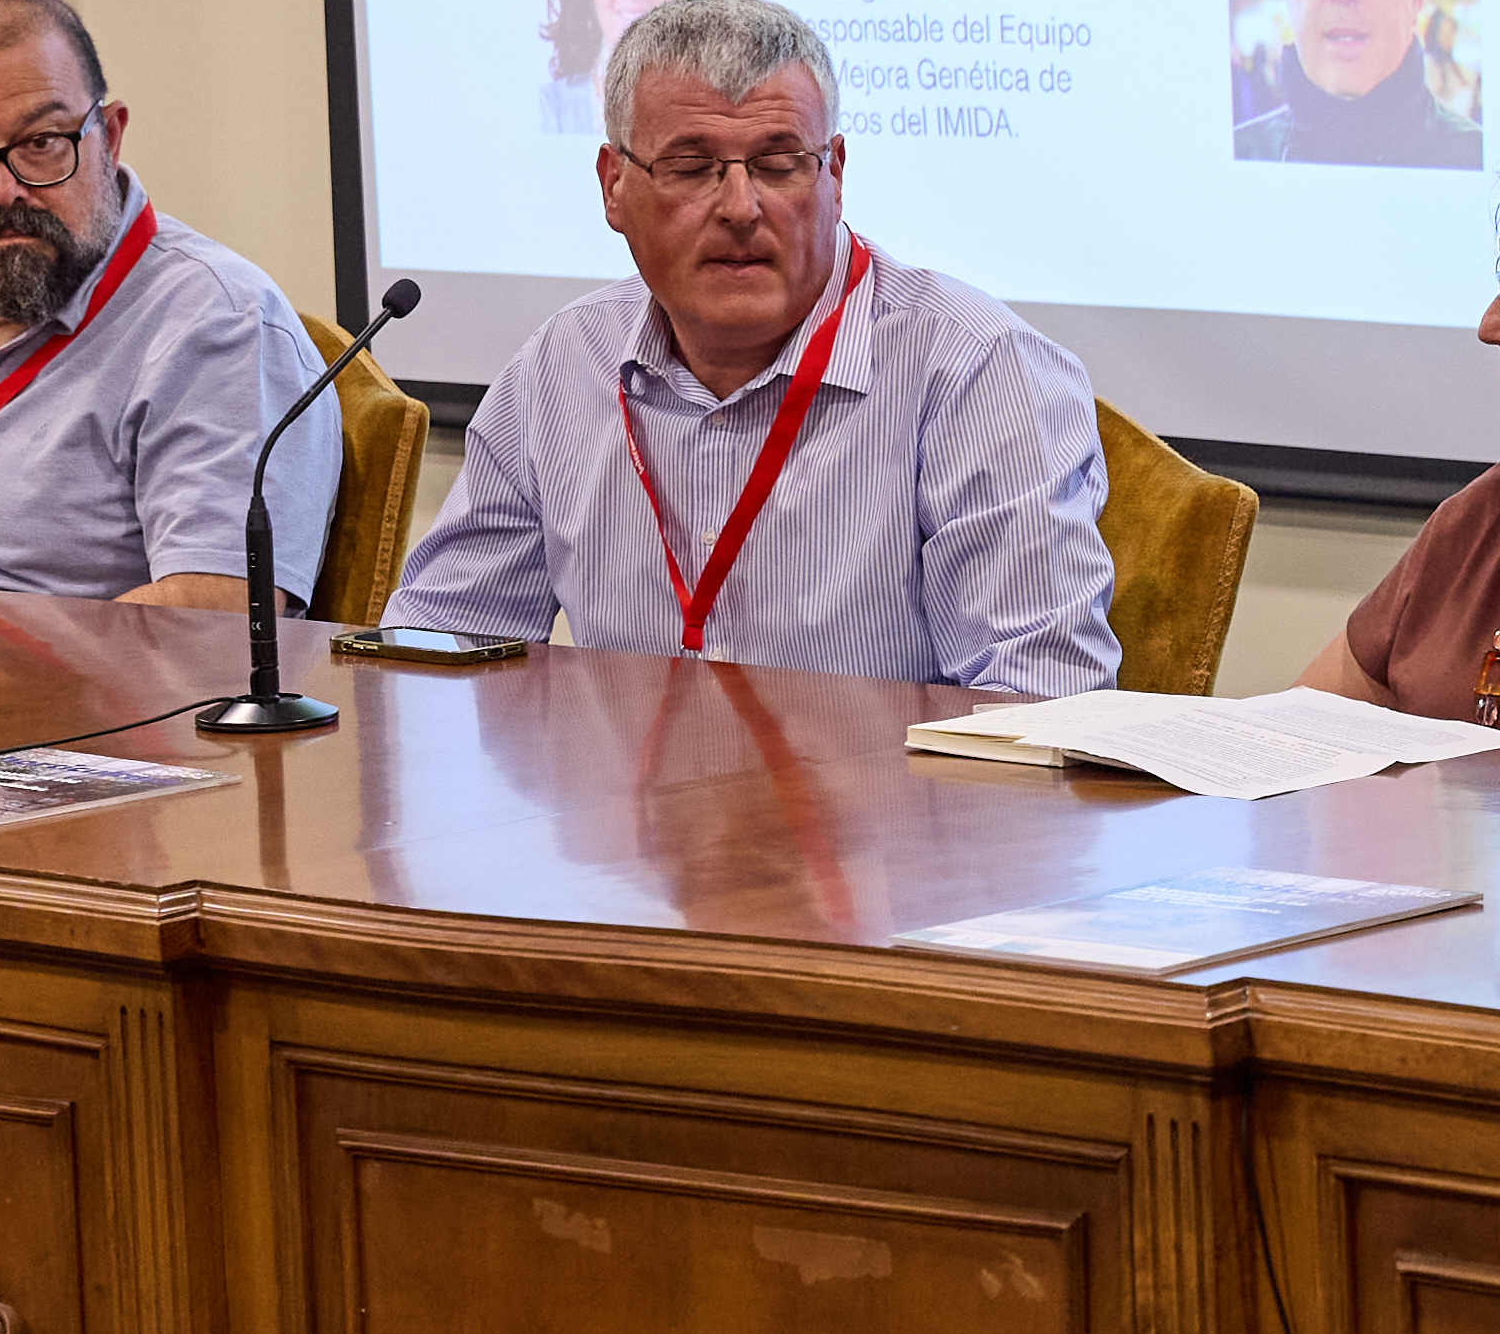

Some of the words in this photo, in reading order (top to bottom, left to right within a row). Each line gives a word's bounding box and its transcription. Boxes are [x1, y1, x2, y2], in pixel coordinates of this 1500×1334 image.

[952, 13, 991, 44] del
[999, 15, 1092, 53] Equipo
[916, 58, 1030, 93] Genética
[1038, 61, 1072, 94] de
[891, 105, 928, 137] del
[936, 105, 1019, 140] IMIDA.
